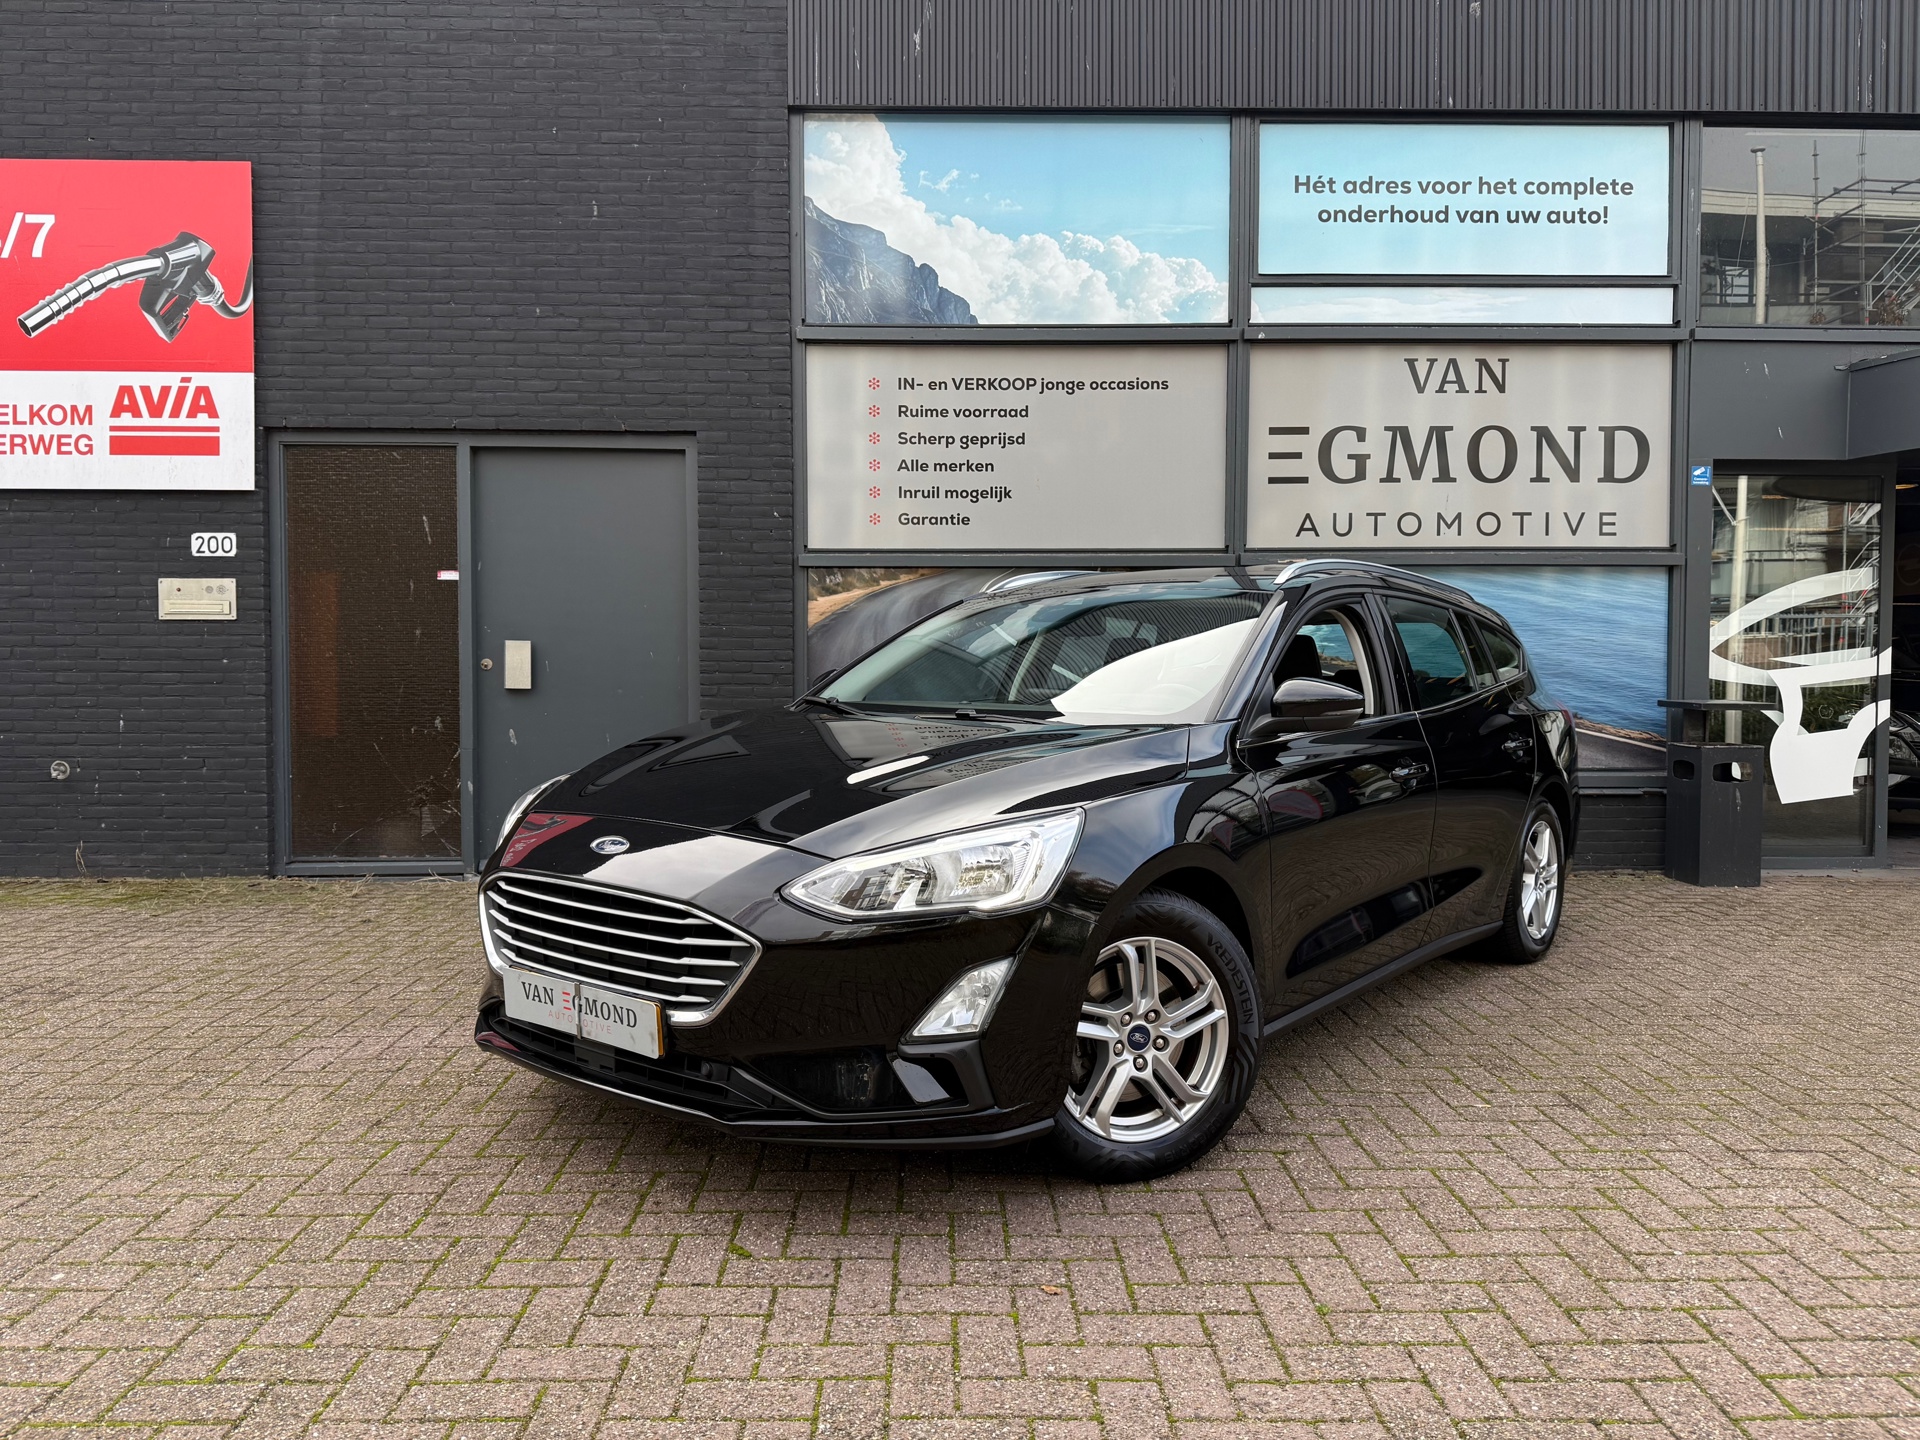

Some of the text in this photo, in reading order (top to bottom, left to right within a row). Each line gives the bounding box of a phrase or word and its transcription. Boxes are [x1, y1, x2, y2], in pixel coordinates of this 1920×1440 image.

[1294, 174, 1635, 201] Hét adres voor het complete
[1317, 204, 1610, 225] onderhoud van uw auto!
[0, 211, 56, 259] /7
[897, 377, 1170, 396] IN- en VERKOOP jonge occasions
[1403, 357, 1510, 395] VAN
[897, 404, 1030, 419] Ruime voorraad
[897, 431, 1026, 450] Scherp geprijsd
[897, 458, 995, 473] Alle merken
[1267, 424, 1651, 485] EGMOND
[897, 485, 1013, 505] Inruil mogelijk
[897, 512, 971, 527] Garantie
[1295, 511, 1619, 538] AUTOMOTIVE
[194, 535, 234, 554] 200
[1205, 930, 1255, 1025] VREDESTEIN
[520, 981, 555, 1007] VAN
[547, 1009, 613, 1035] AUTOOTIVE
